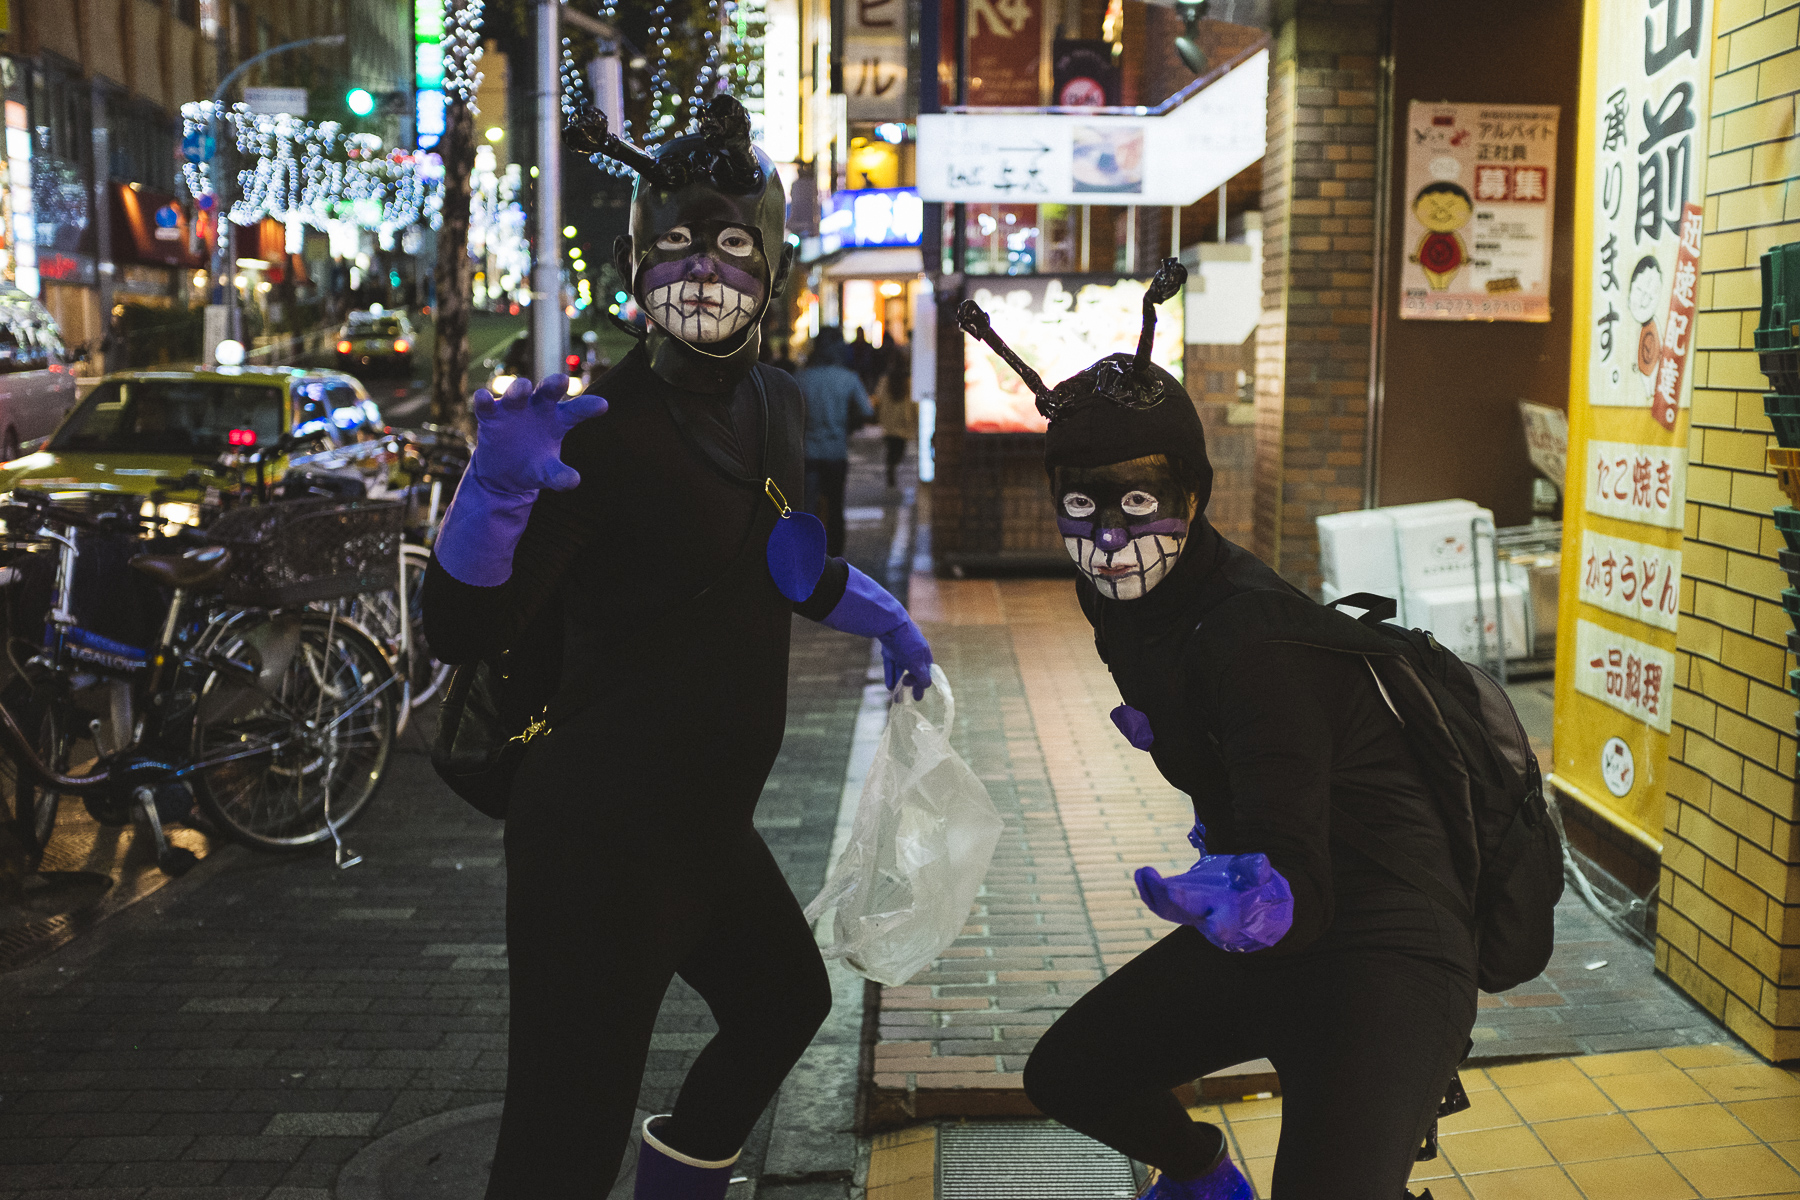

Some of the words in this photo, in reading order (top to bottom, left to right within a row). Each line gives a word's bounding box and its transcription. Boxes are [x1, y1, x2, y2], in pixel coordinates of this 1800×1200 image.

[1478, 121, 1554, 141] アルバイト
[1598, 87, 1629, 384] 承ります。
[1597, 456, 1671, 509] たこ焼き
[1585, 547, 1677, 615] かすうどん
[1590, 648, 1662, 716] 一品料理
